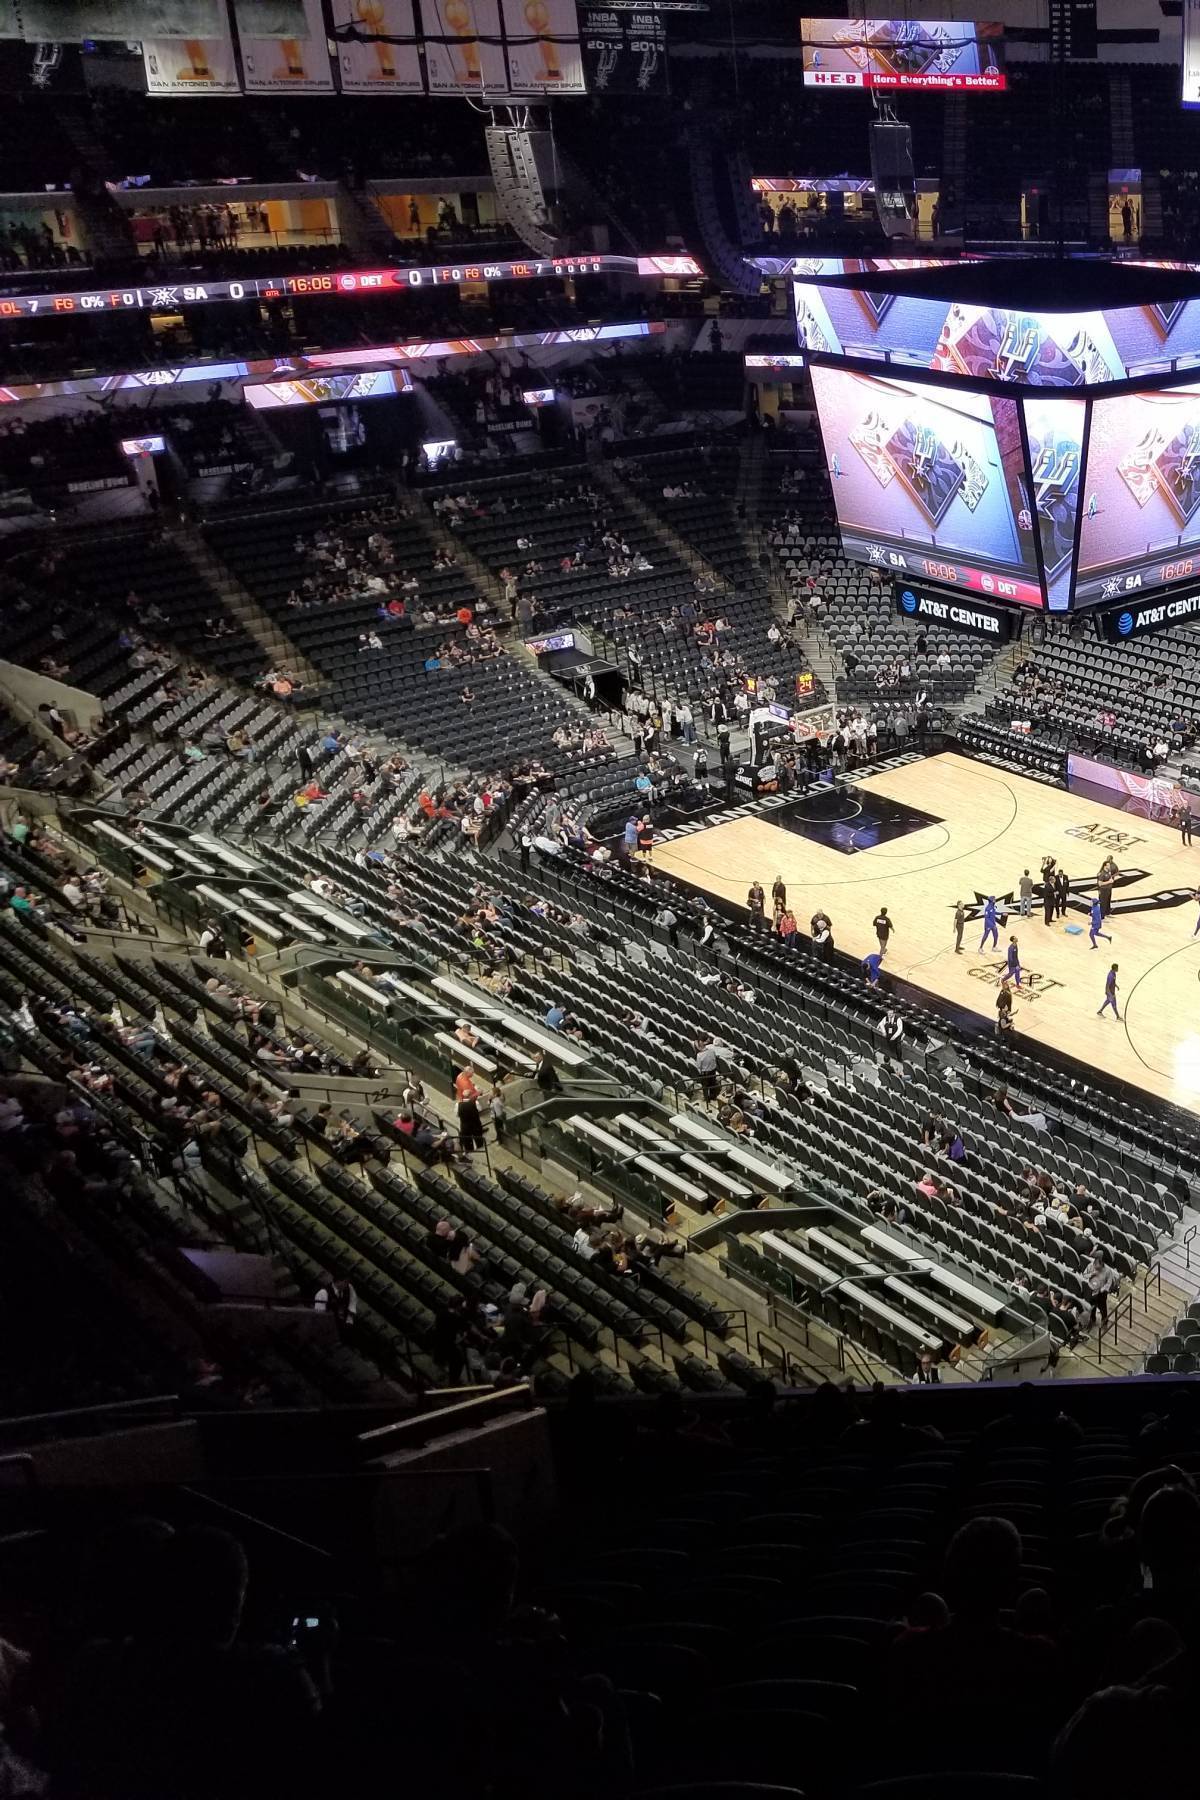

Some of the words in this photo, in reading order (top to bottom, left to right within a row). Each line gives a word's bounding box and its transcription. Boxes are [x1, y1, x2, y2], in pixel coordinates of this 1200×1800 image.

[150, 80, 170, 88] SAN
[171, 80, 209, 88] ANTONIO
[561, 82, 583, 90] SPURS
[873, 74, 896, 83] Here
[900, 75, 961, 87] Everything's
[288, 277, 332, 292] 16:06
[360, 275, 383, 286] DET
[409, 270, 422, 286] 0
[442, 271, 450, 280] F
[452, 269, 460, 280] 0
[465, 268, 480, 279] FG
[484, 267, 501, 278] 0%
[510, 264, 530, 275] TOL
[535, 263, 543, 274] 7
[28, 301, 38, 312] 7
[55, 298, 74, 310] FG
[81, 296, 104, 308] 0%
[110, 295, 120, 306] F
[123, 294, 134, 304] 0
[183, 287, 209, 300] SA
[229, 283, 244, 299] 0
[889, 553, 907, 568] SA
[922, 560, 958, 582] 16:06
[998, 582, 1017, 596] DET
[1125, 575, 1142, 589] SA
[1159, 560, 1193, 581] 16:06
[918, 599, 949, 619] AT&T
[950, 606, 1000, 633] CENTER
[1136, 605, 1166, 628] AT&T
[835, 750, 927, 784] SPURS
[973, 752, 1061, 783] SPURS.COM
[1064, 828, 1129, 853] CENTER
[1074, 823, 1150, 847] AT&T
